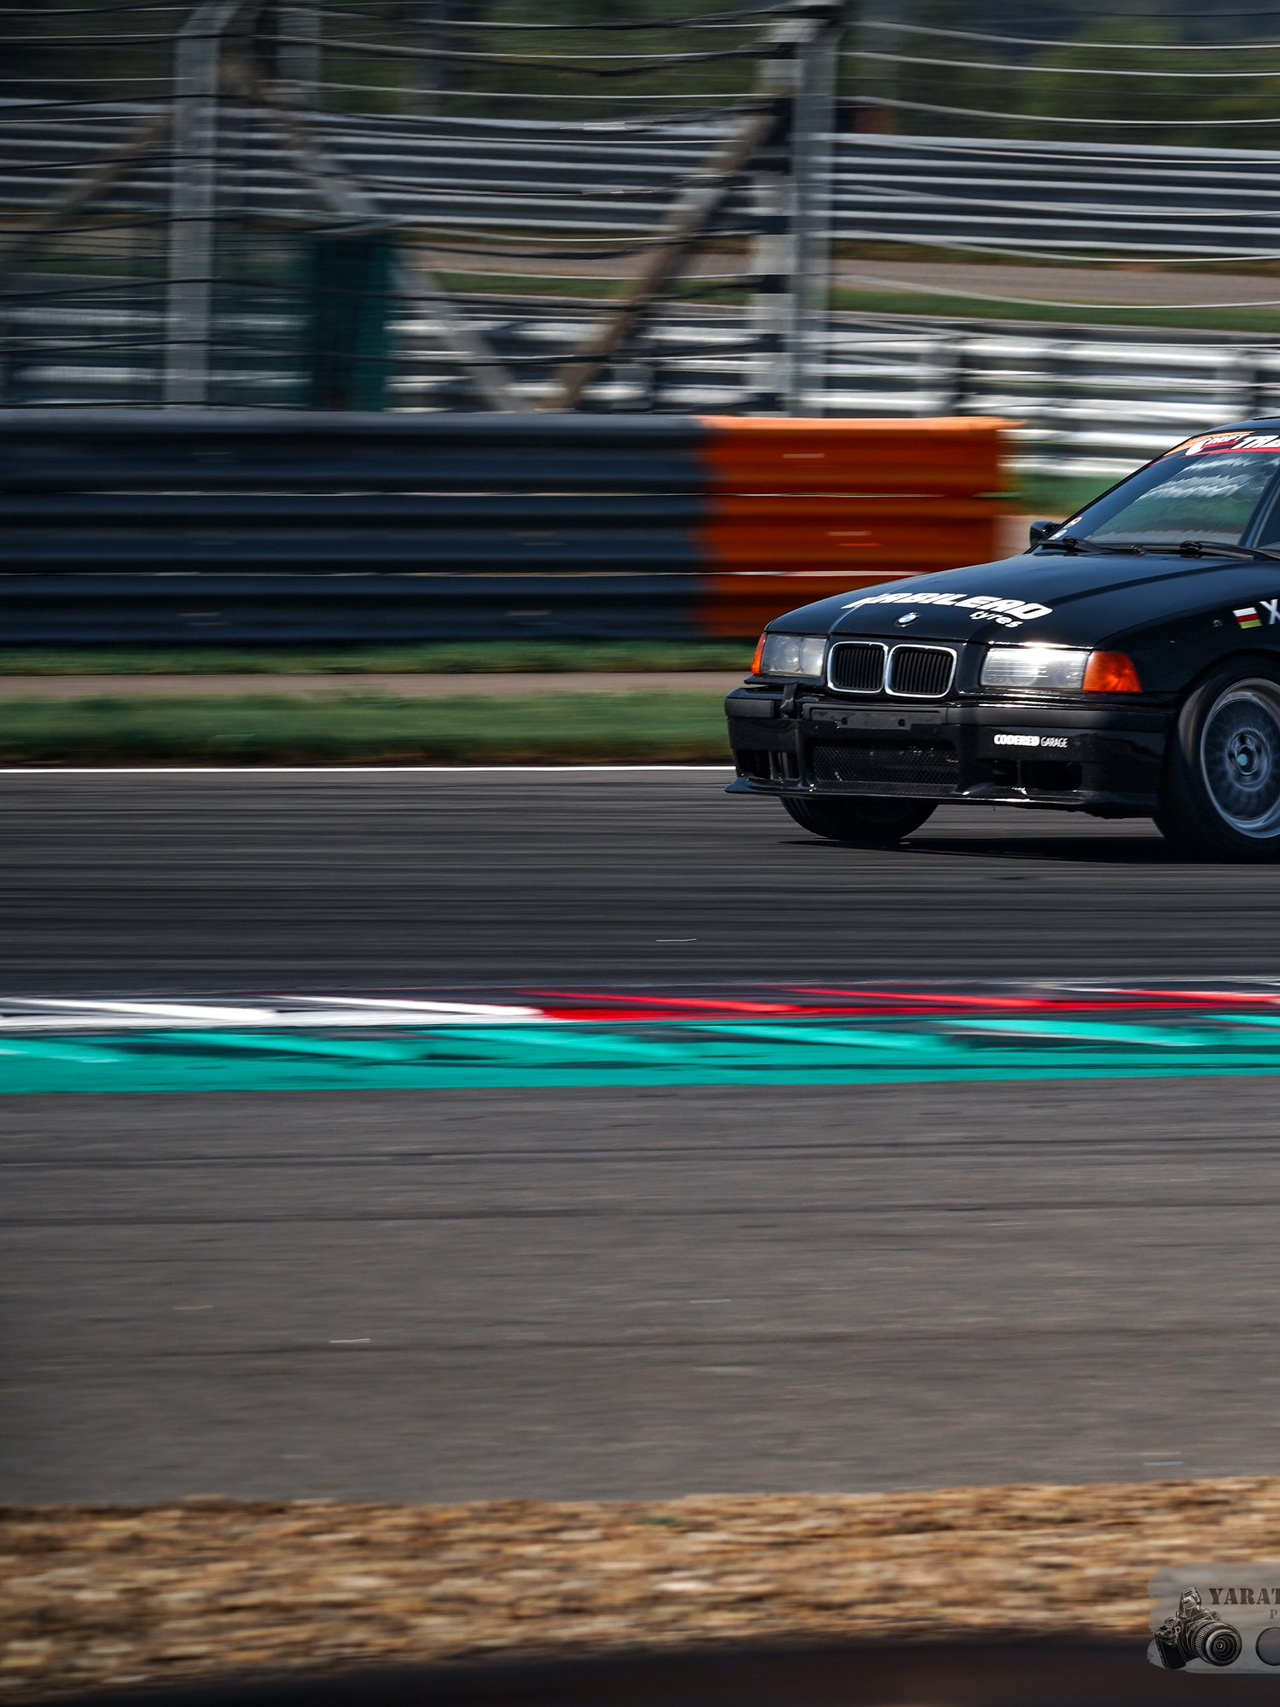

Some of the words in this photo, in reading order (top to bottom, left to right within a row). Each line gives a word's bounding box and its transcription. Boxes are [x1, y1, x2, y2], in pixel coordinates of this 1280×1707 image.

[841, 592, 1053, 620] HABILEAD
[969, 610, 1023, 628] tyres
[1041, 736, 1068, 748] GARAGE
